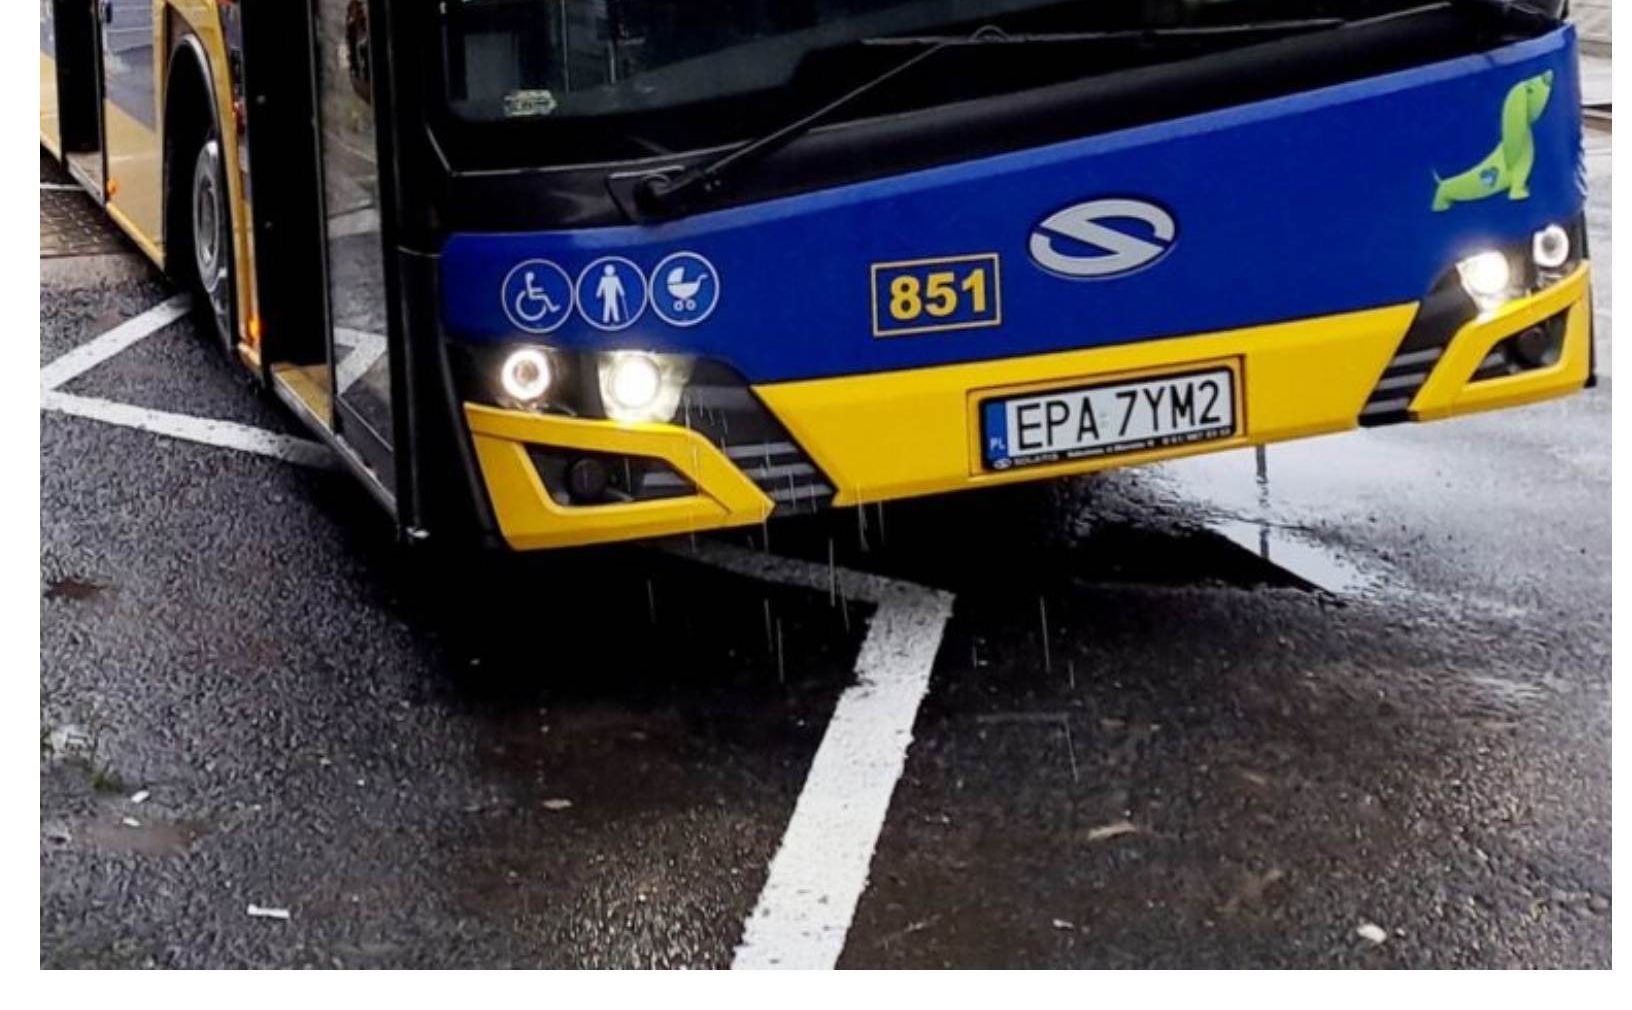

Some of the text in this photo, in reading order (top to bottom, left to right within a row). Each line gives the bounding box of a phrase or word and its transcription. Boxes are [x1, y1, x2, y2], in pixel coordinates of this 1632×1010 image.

[889, 269, 987, 321] 851
[1017, 395, 1099, 451] EPA
[1115, 380, 1221, 438] 7YM2
[990, 439, 1006, 451] PL
